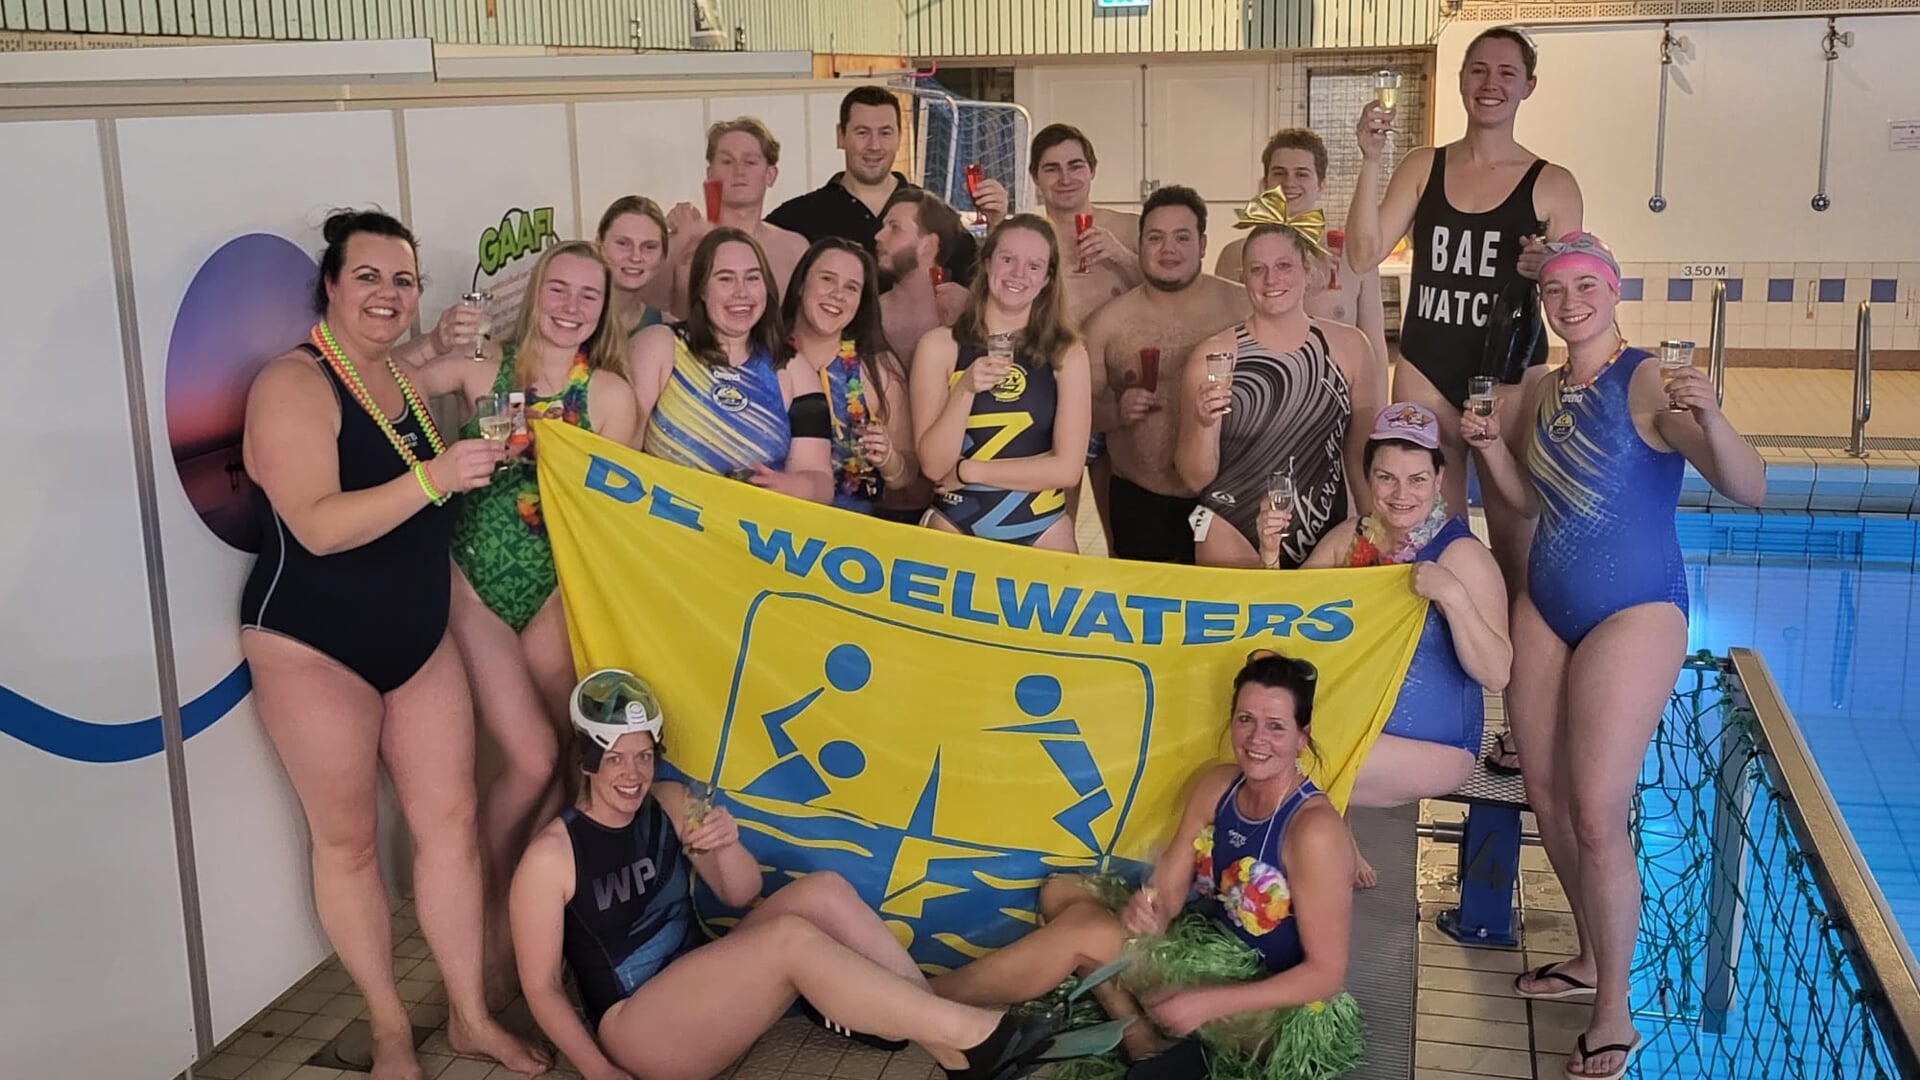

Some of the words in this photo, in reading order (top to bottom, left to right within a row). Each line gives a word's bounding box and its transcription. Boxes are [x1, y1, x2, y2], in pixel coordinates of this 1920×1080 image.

[479, 207, 554, 276] GAAF!
[1431, 225, 1501, 278] BAE
[1683, 265, 1712, 277] 3.50
[1714, 265, 1726, 277] M
[1418, 284, 1499, 328] WATC
[584, 453, 705, 533] DE
[737, 518, 1355, 647] WOELWATERS
[591, 856, 657, 911] WP
[1467, 831, 1509, 892] 4
